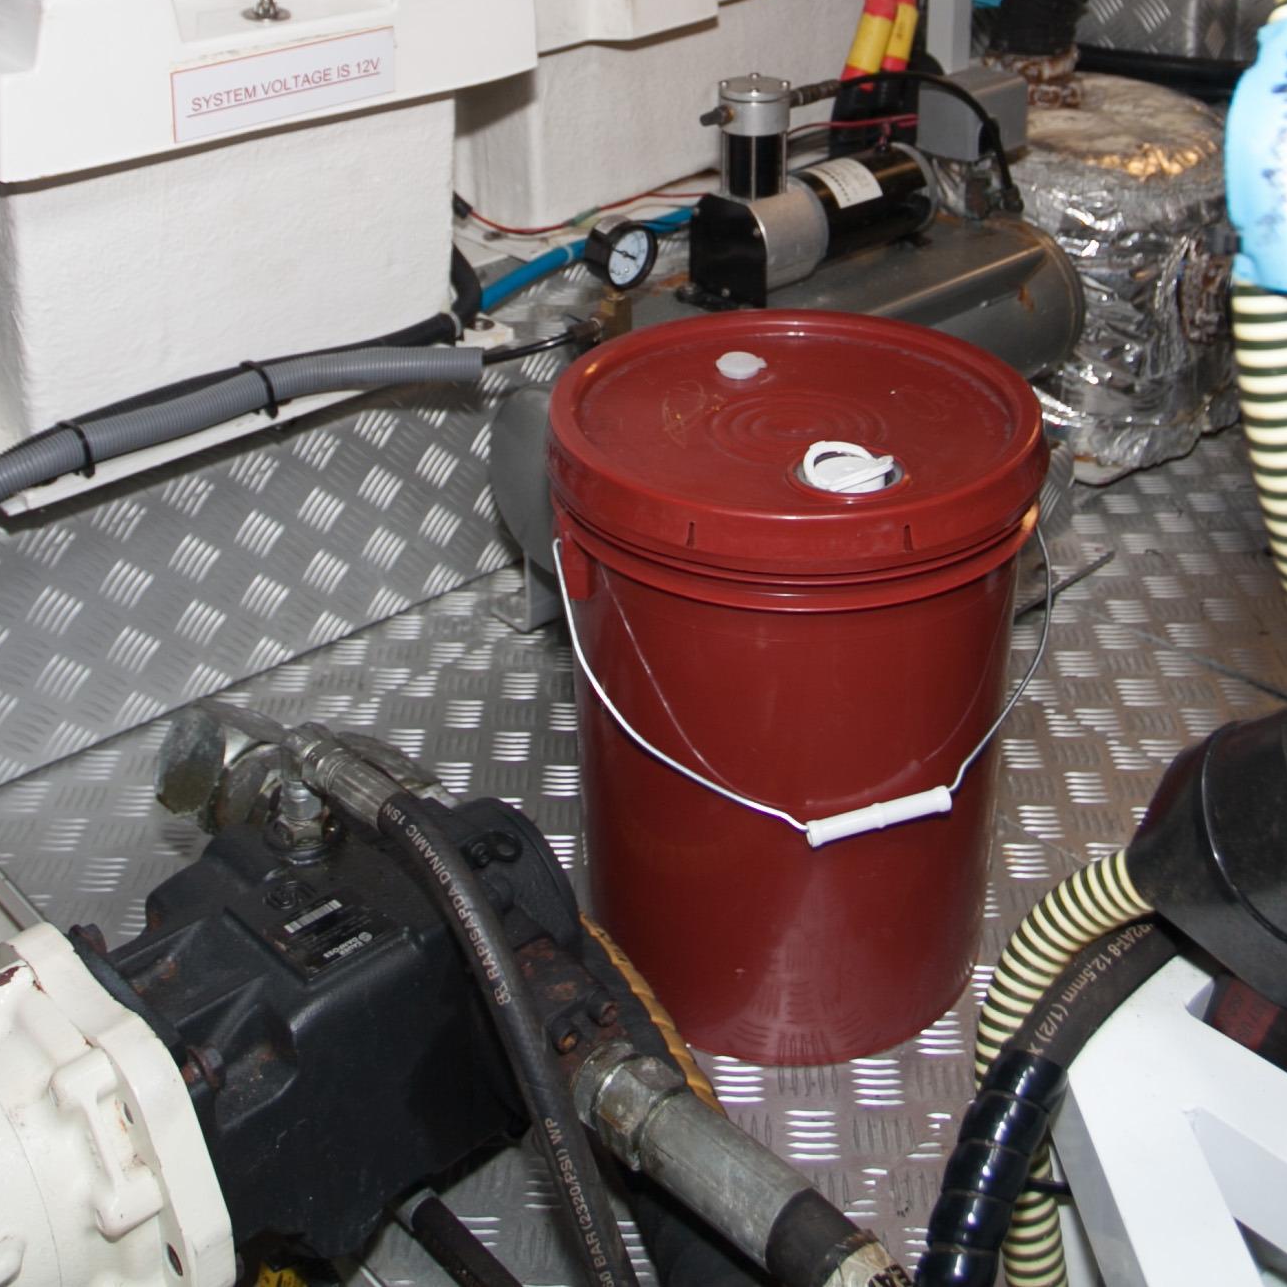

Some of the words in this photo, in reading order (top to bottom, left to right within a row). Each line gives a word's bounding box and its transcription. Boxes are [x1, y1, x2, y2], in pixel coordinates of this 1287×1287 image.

[191, 84, 257, 113] SYSTEM
[260, 67, 332, 96] VOLTAGE
[336, 63, 351, 79] IS
[356, 57, 380, 74] 12V
[405, 823, 452, 885] DINAMIC
[448, 885, 501, 981] RAPISARDA
[1034, 1003, 1069, 1043] (1/2)
[544, 1117, 563, 1146] WP
[584, 1230, 607, 1267] BAR
